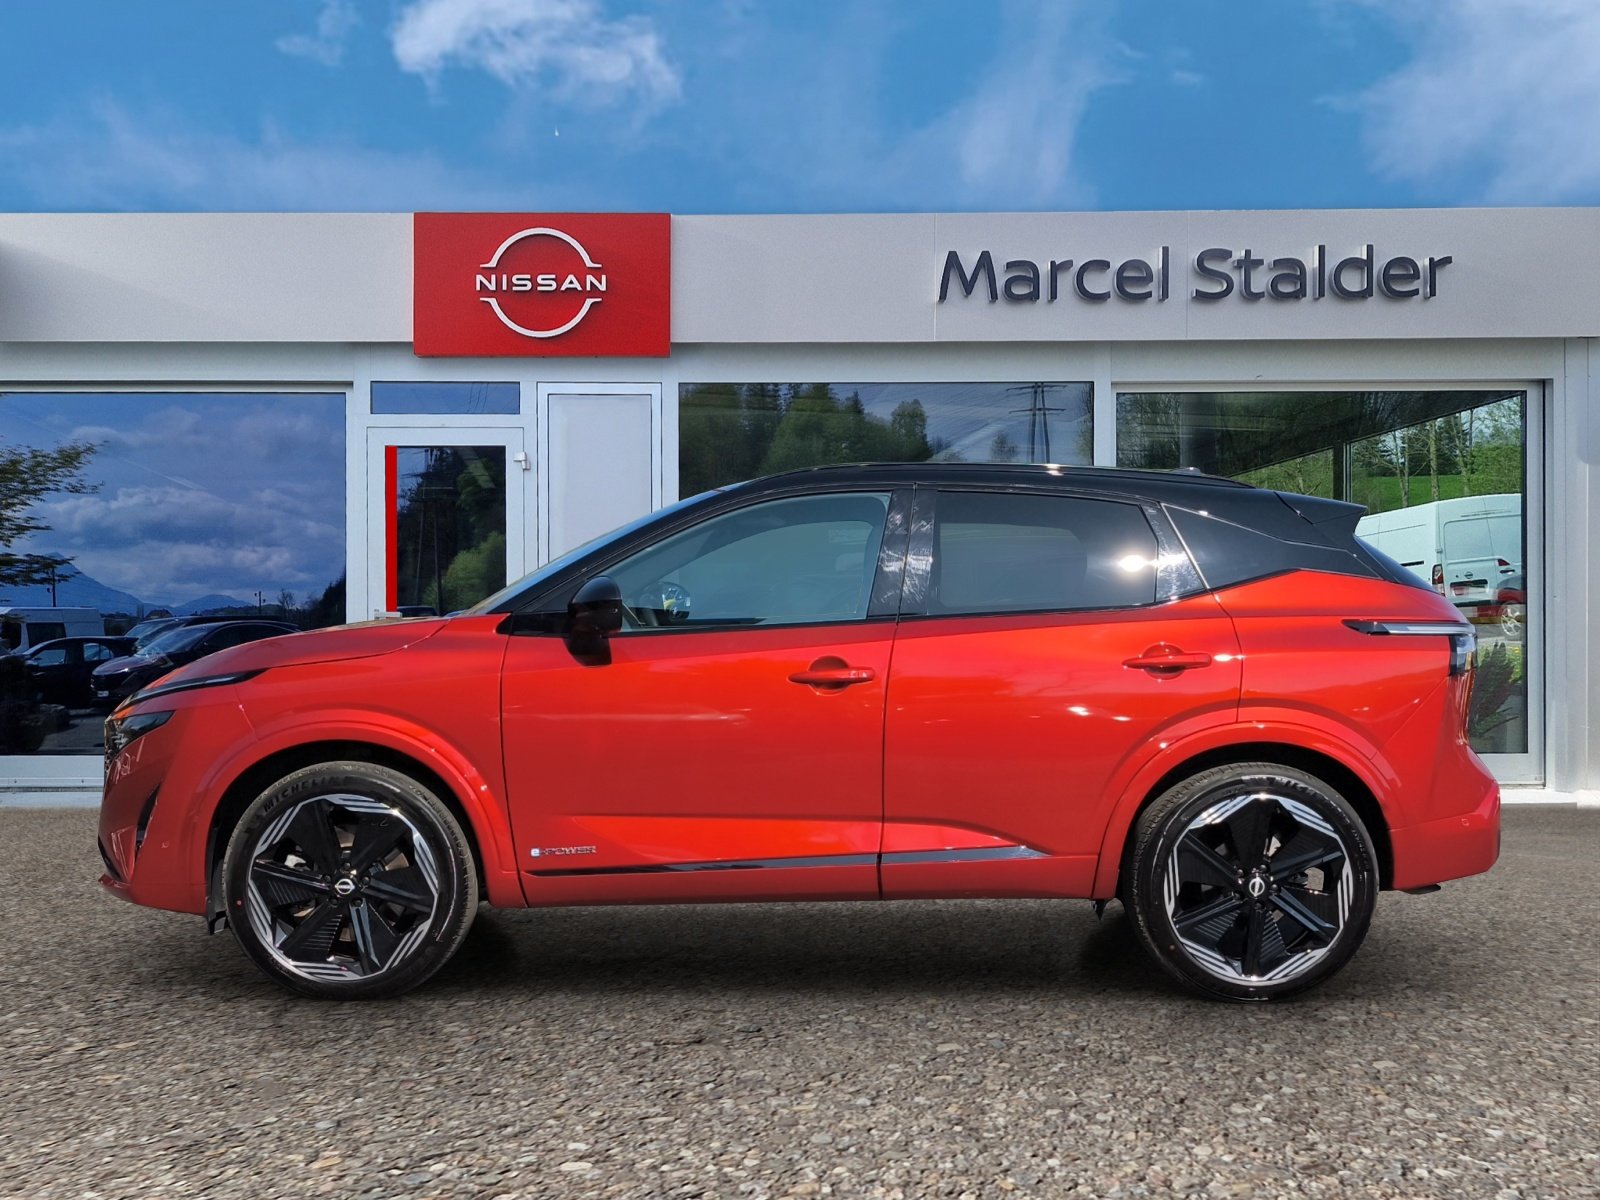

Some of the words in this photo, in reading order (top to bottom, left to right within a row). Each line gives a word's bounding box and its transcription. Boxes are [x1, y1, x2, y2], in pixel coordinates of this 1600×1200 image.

[475, 274, 607, 291] NISSAN
[938, 246, 1170, 303] Marcel
[1192, 244, 1453, 300] Stalder
[263, 776, 338, 813] MICHELIN
